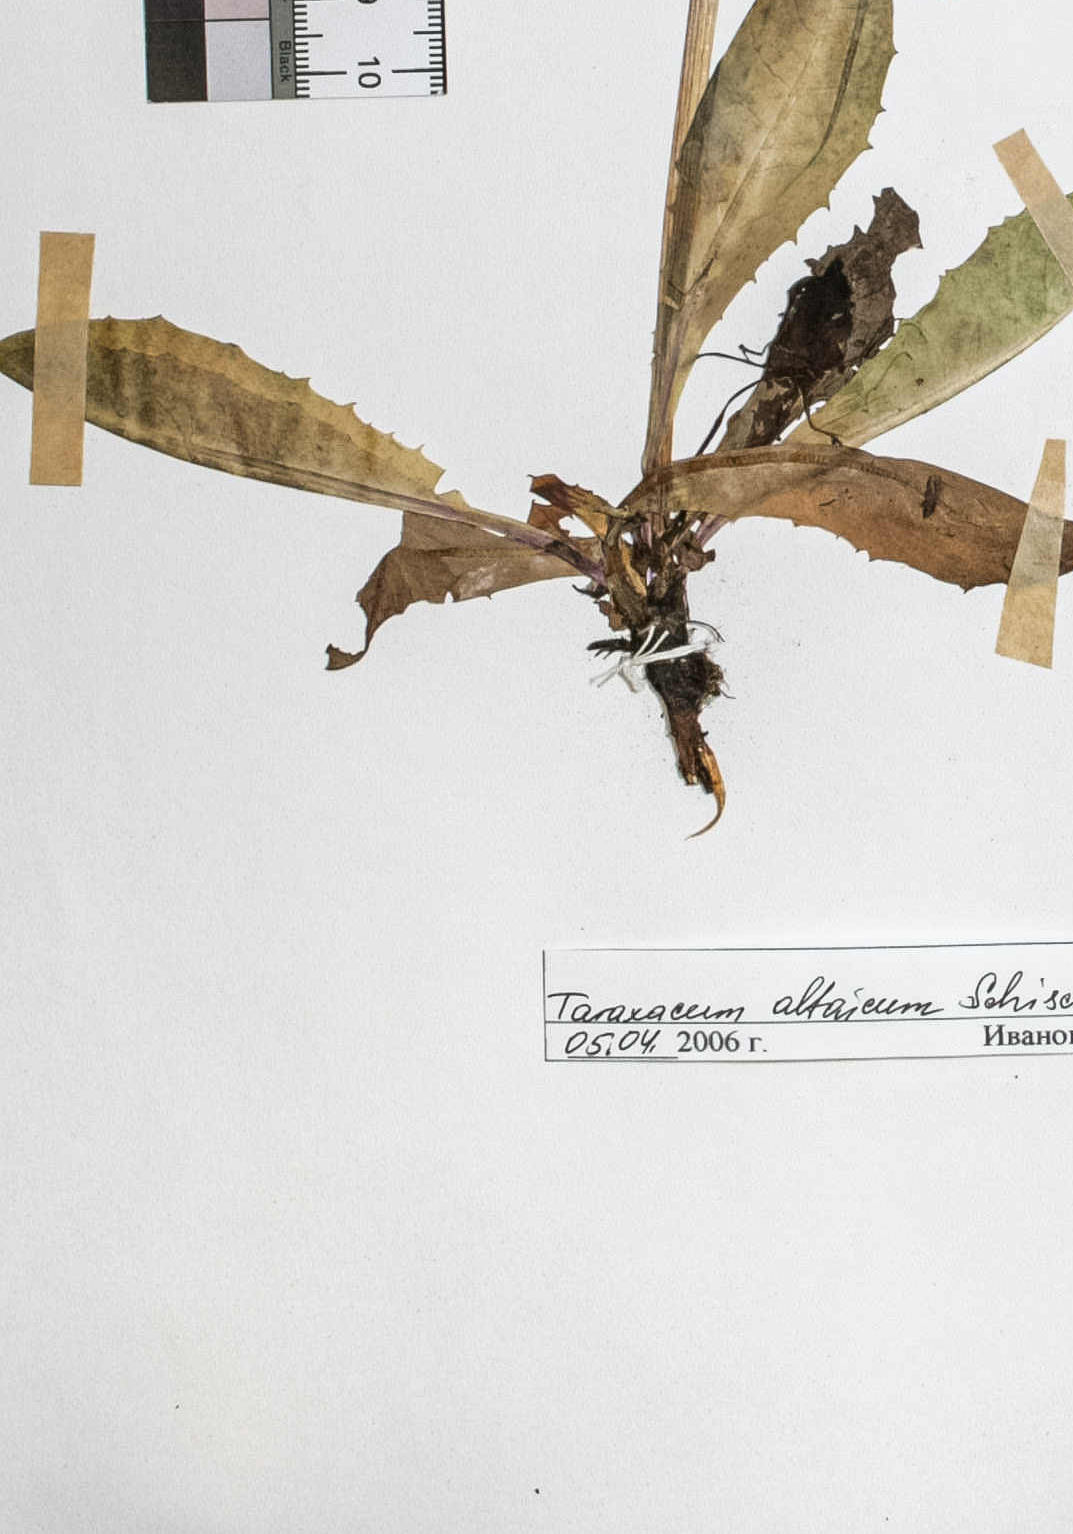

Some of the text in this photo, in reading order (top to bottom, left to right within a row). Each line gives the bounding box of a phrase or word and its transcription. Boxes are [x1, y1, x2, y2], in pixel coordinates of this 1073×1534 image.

[278, 40, 291, 82] Black
[358, 57, 382, 88] 10
[677, 1031, 740, 1054] 2006
[748, 1037, 767, 1053] г.
